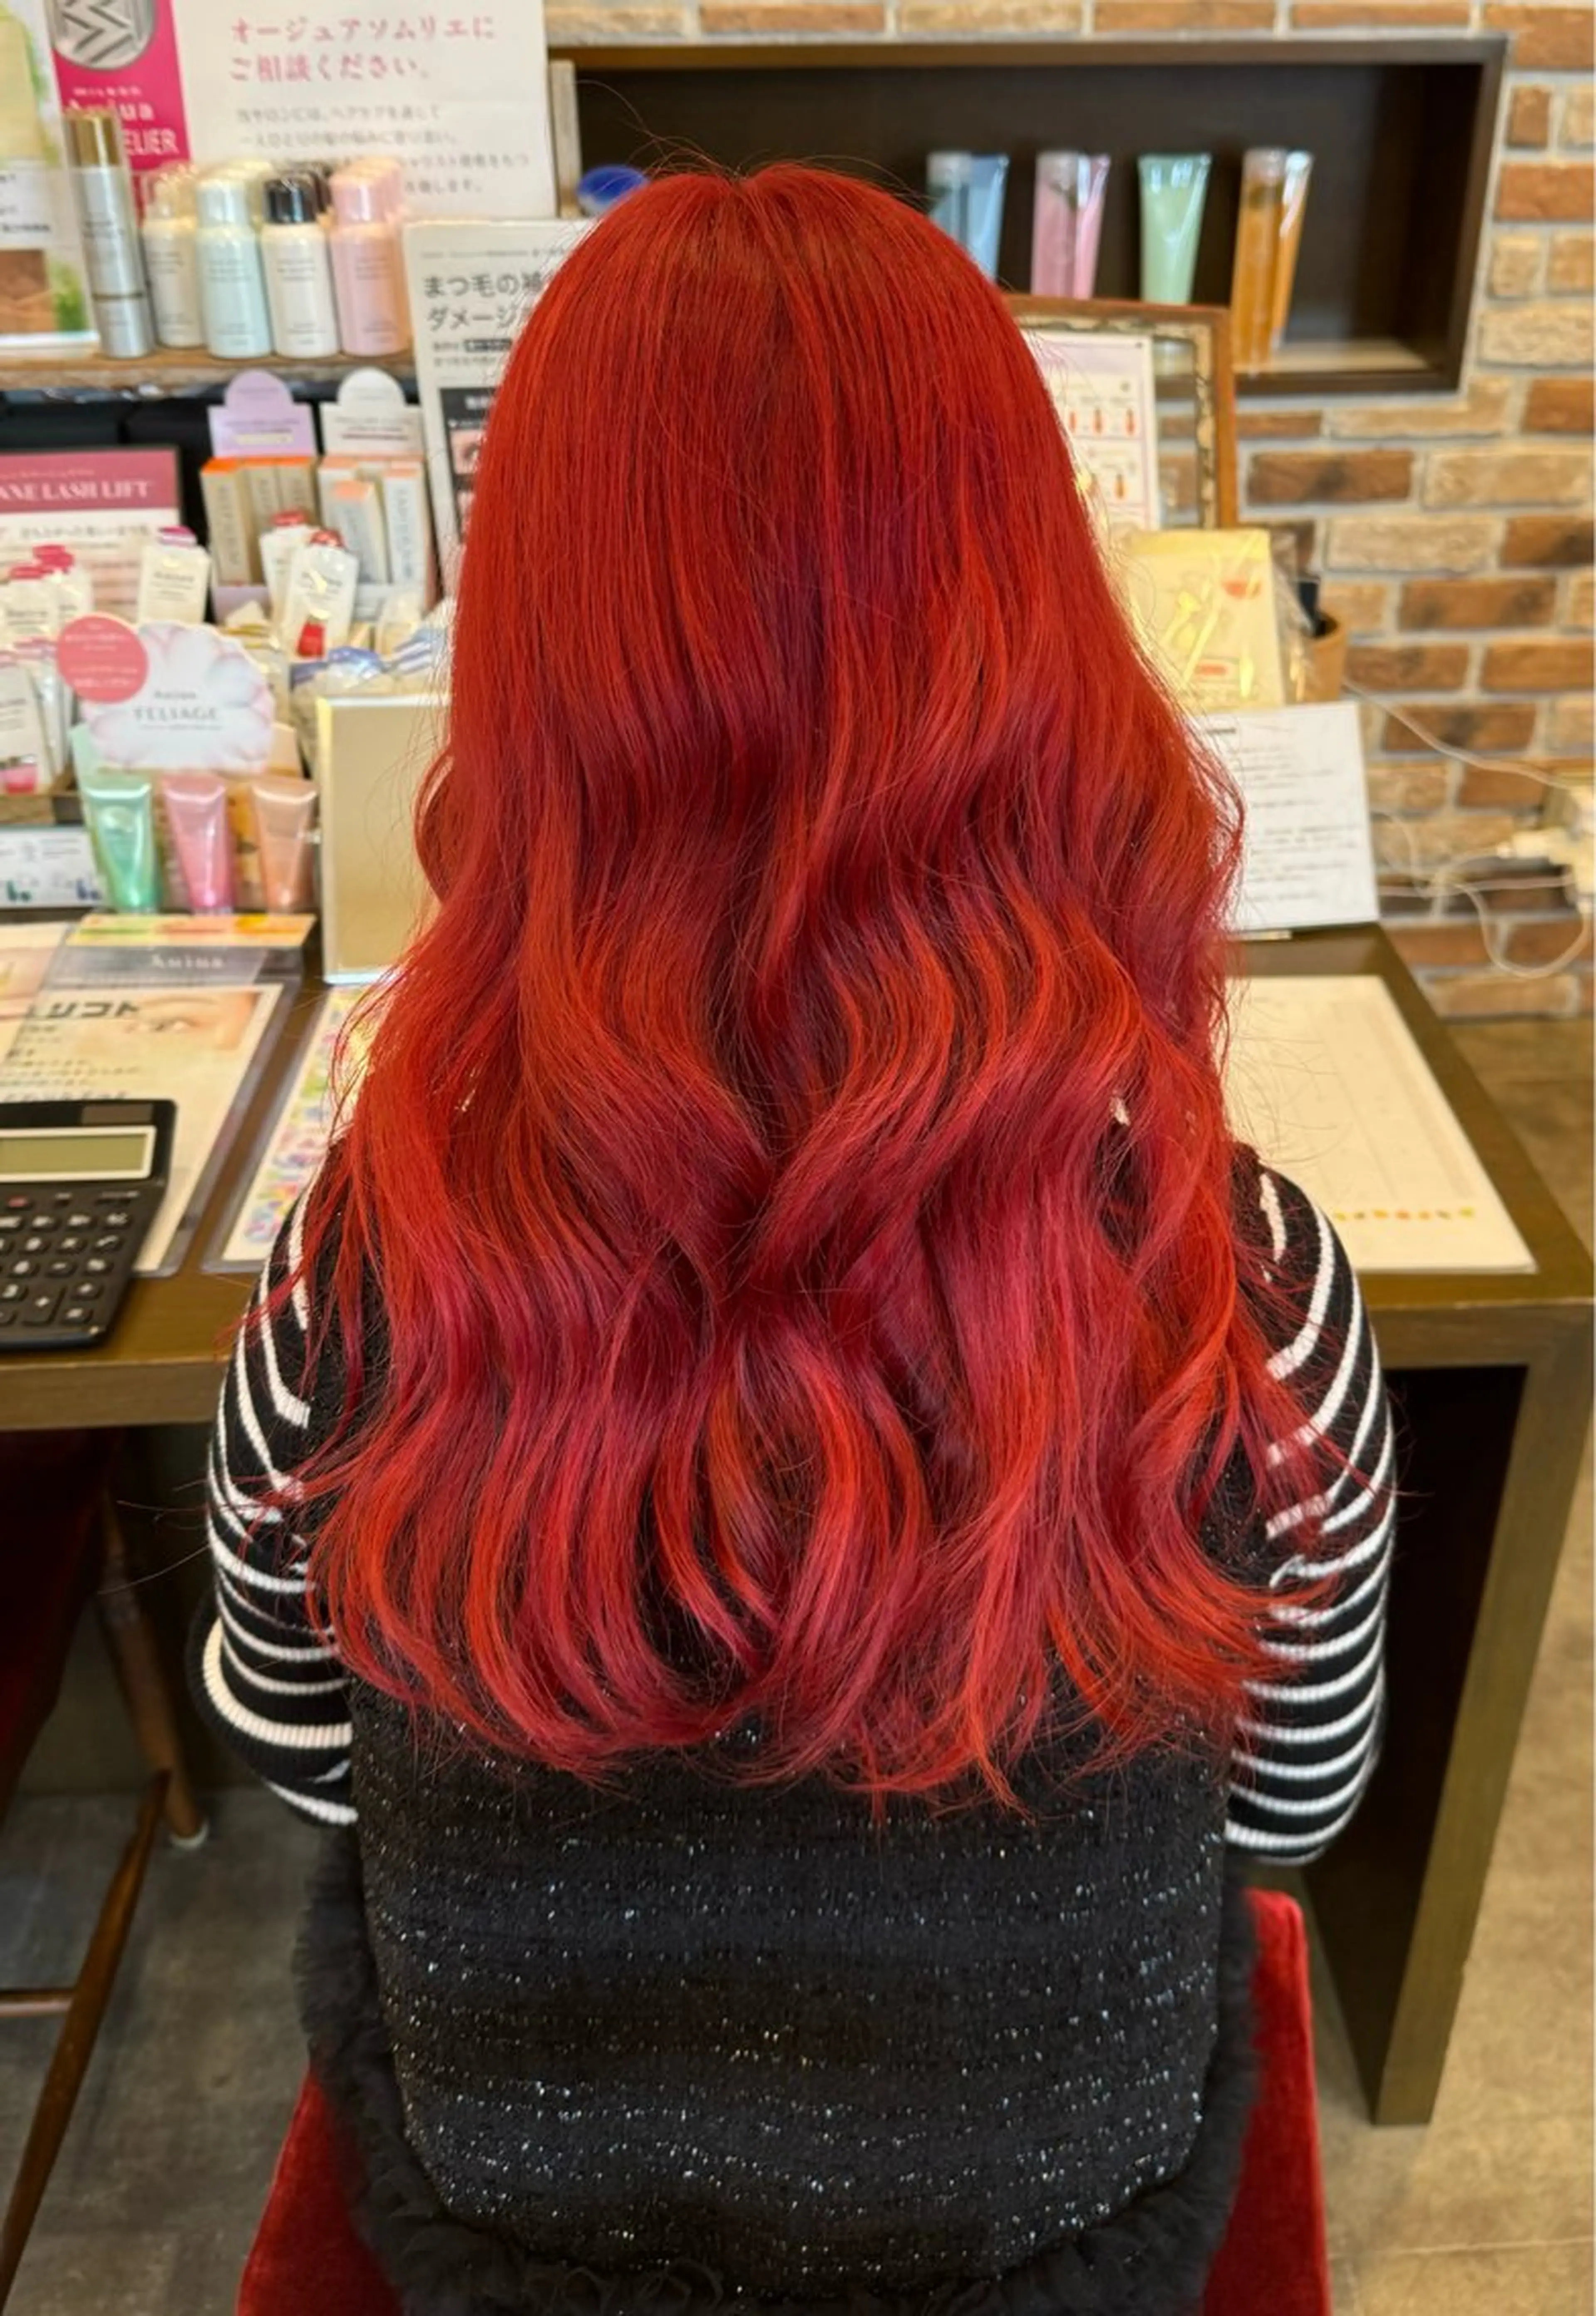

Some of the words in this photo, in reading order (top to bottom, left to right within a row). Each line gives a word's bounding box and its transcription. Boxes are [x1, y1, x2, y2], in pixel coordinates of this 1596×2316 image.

[231, 16, 495, 44] オージュアソムリエに
[229, 52, 429, 82] ご相談ください。
